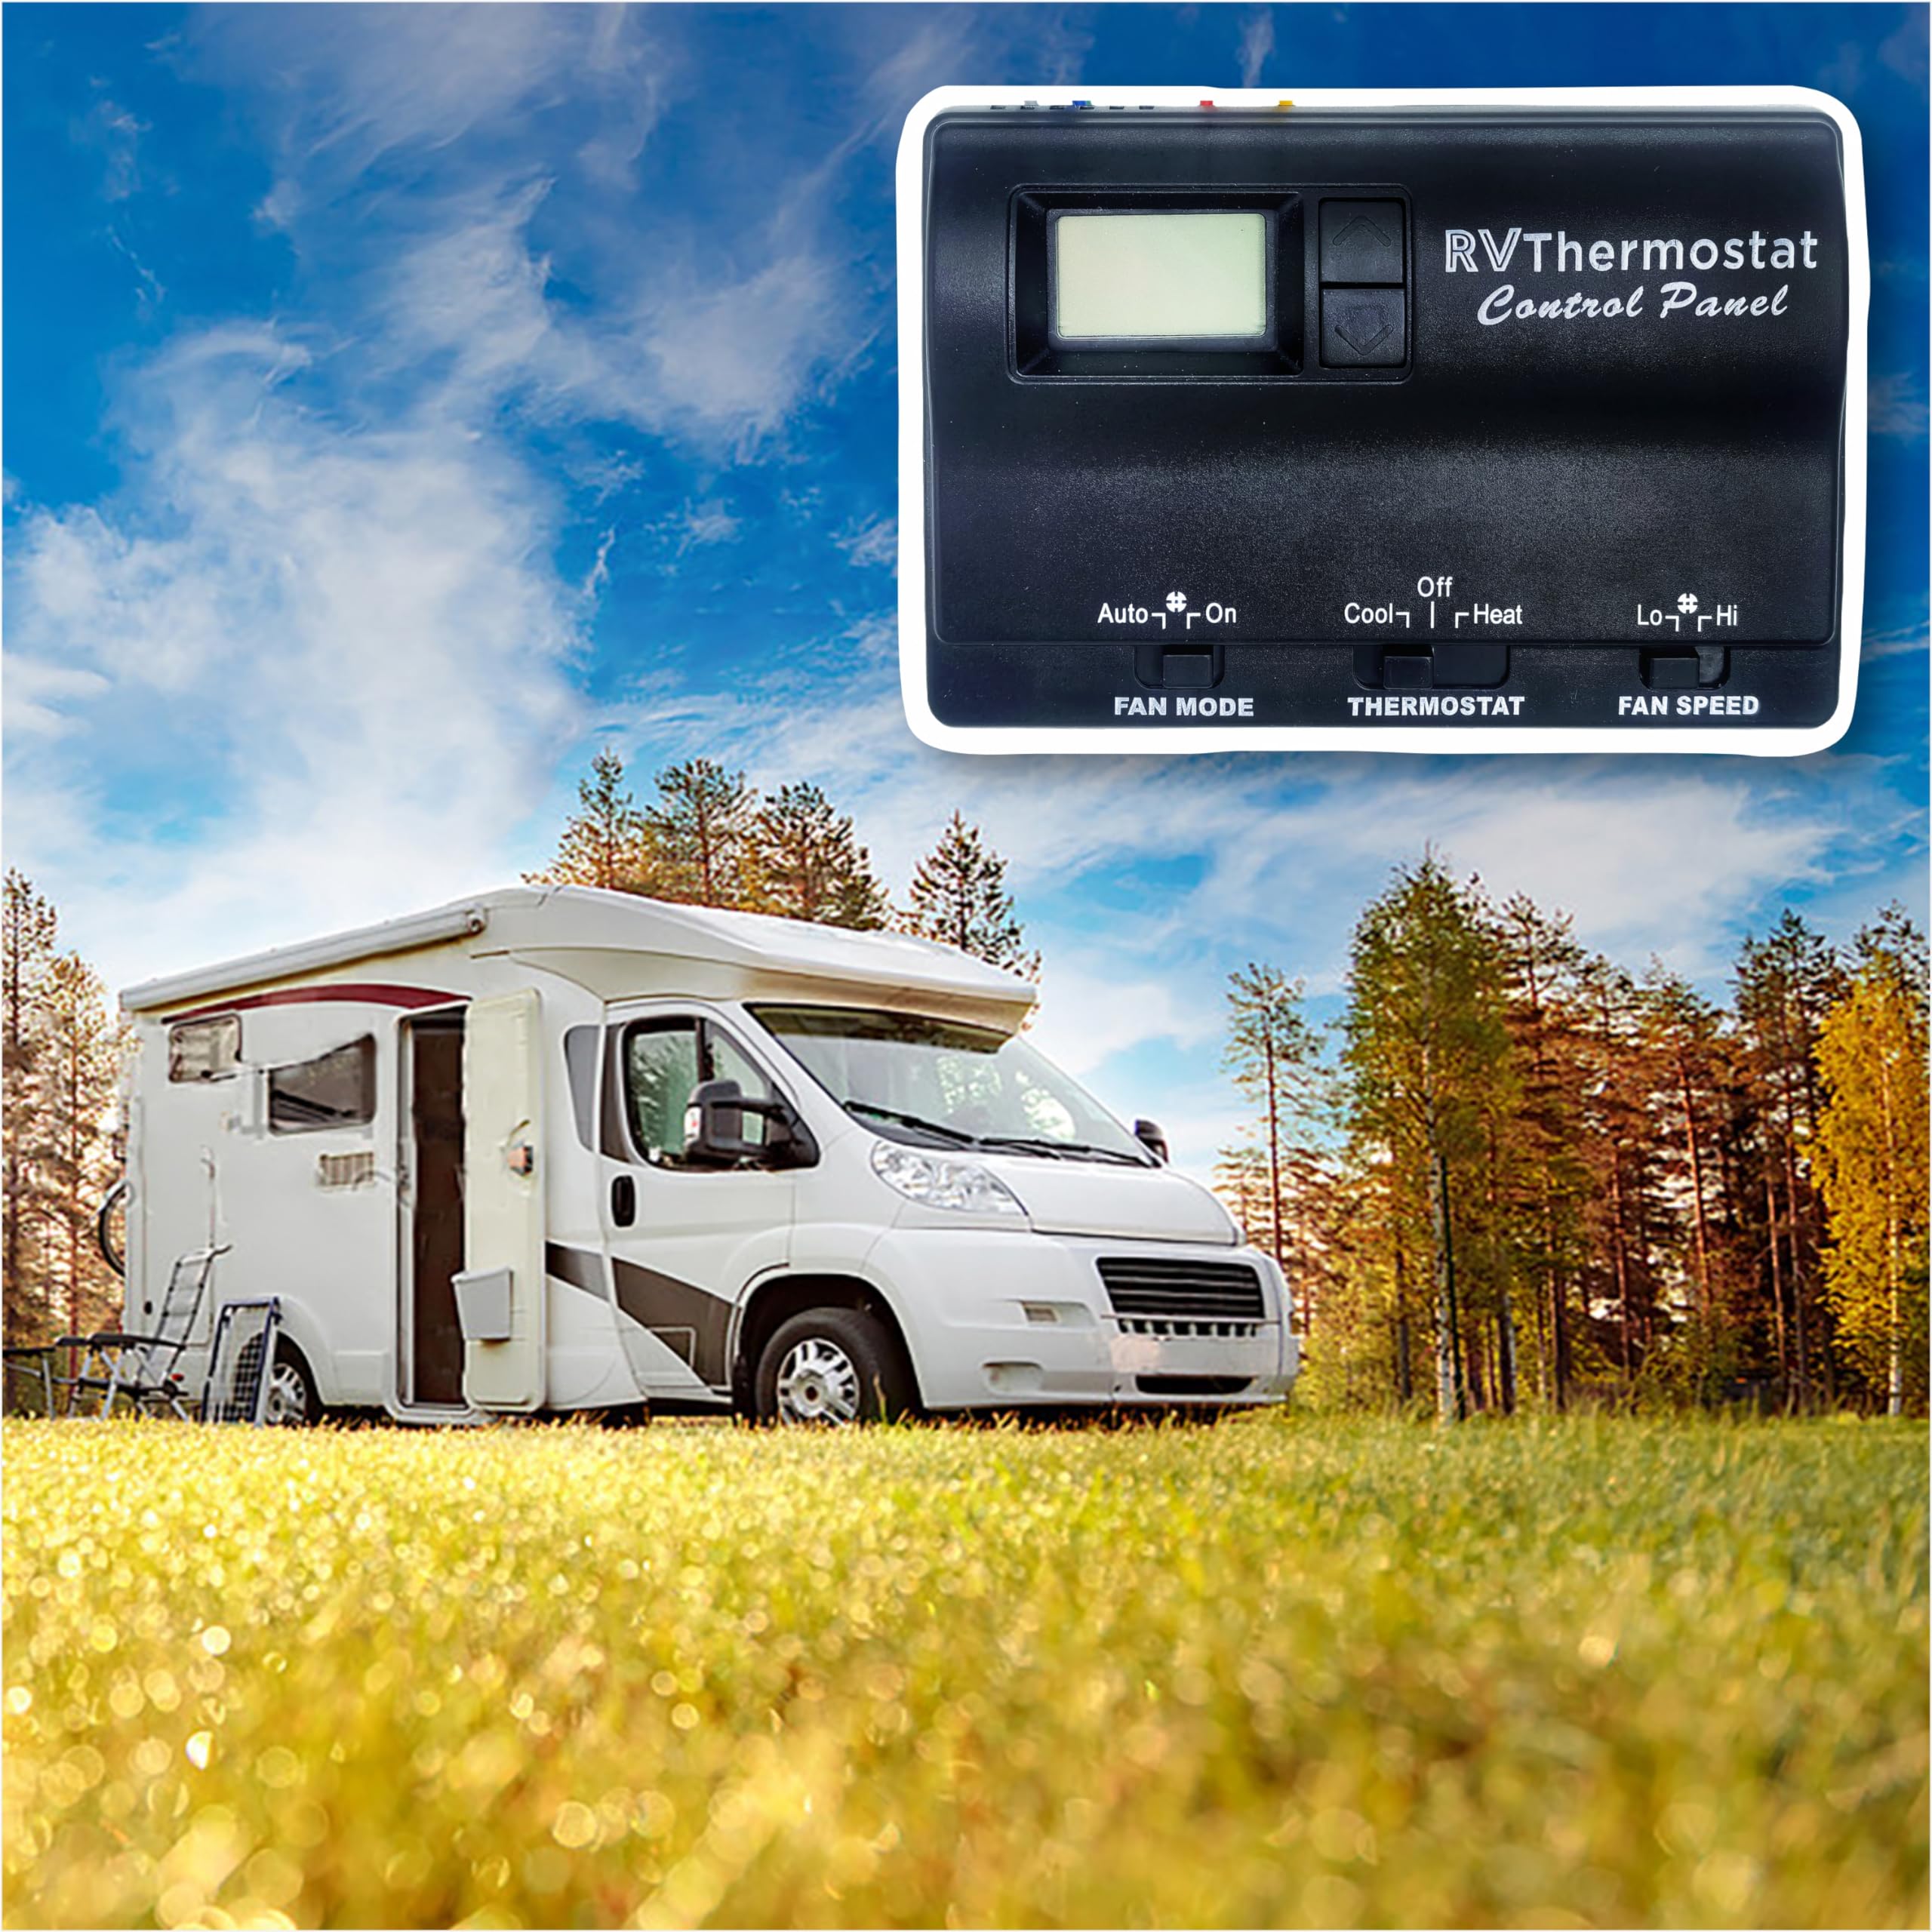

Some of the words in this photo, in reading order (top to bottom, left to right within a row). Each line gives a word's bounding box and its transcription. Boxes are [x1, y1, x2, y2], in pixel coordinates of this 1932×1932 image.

[1477, 284, 1644, 326] Control
[1660, 281, 1789, 318] Panel
[1417, 576, 1454, 598] Off
[1097, 602, 1149, 624] Auto
[1205, 601, 1237, 624] On
[1344, 601, 1393, 624] Cool
[1473, 603, 1523, 625] Heat
[1637, 604, 1663, 626] Lo
[1716, 604, 1738, 626] Hi
[1114, 697, 1167, 716] FAN
[1176, 697, 1254, 717] MODE
[1347, 696, 1525, 716] THERMOSTAT
[1618, 695, 1669, 715] FAN
[1675, 695, 1759, 715] SPEED
